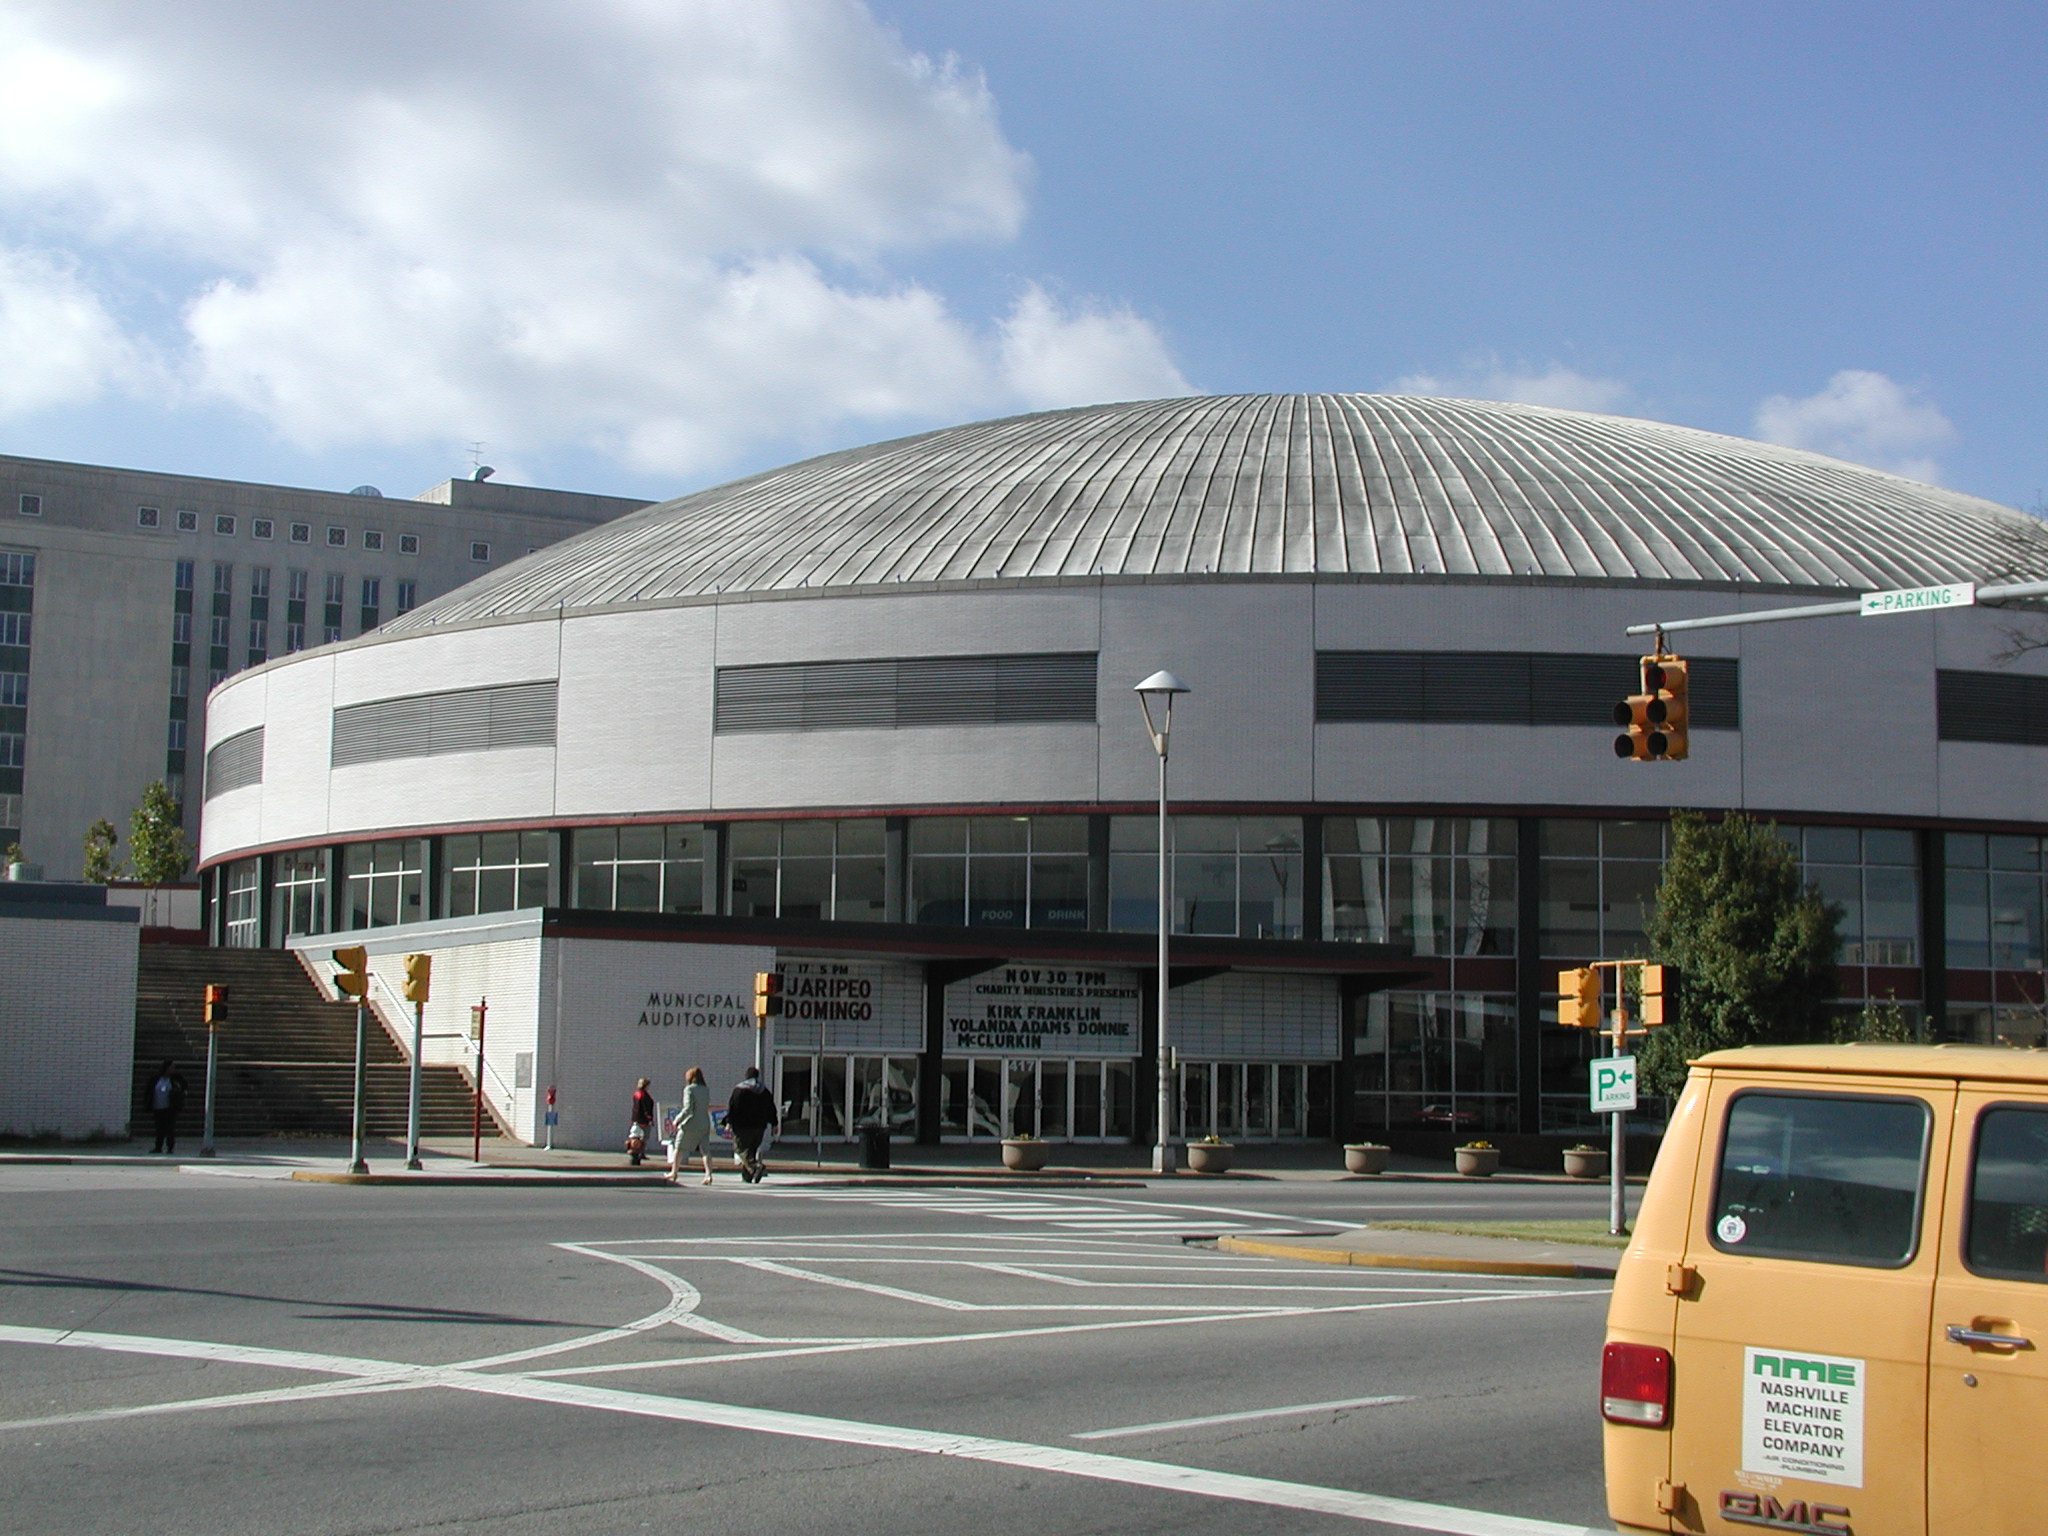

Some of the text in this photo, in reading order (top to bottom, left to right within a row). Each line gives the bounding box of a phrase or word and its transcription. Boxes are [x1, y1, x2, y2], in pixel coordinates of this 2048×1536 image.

[1884, 589, 1951, 610] PARKING
[981, 910, 1014, 920] FOOD
[799, 964, 809, 974] 17
[832, 965, 849, 975] PM
[1005, 968, 1106, 986] NOV 30 7PM
[786, 977, 872, 999] JARIPEO
[975, 984, 1139, 999] CHARITY MINISTRIES PRESENTS
[647, 992, 745, 1010] MUNICIPAL
[784, 999, 872, 1021] DOMINGO
[638, 1011, 751, 1028] AUDITORIUM
[987, 1004, 1101, 1021] KIRK FRANKLIN
[950, 1018, 1130, 1036] YOLANDA ADAMS DONNIE
[957, 1033, 1042, 1049] McCLURKIN
[1008, 1059, 1036, 1073] 417
[1760, 1381, 1849, 1405] NASHVILLE
[1766, 1400, 1842, 1422] MACHINE
[1763, 1418, 1844, 1441] ELEVATOR
[1762, 1436, 1845, 1459] COMPANY
[1781, 1456, 1845, 1471] CONDITIONING
[1719, 1488, 1850, 1531] GMC
